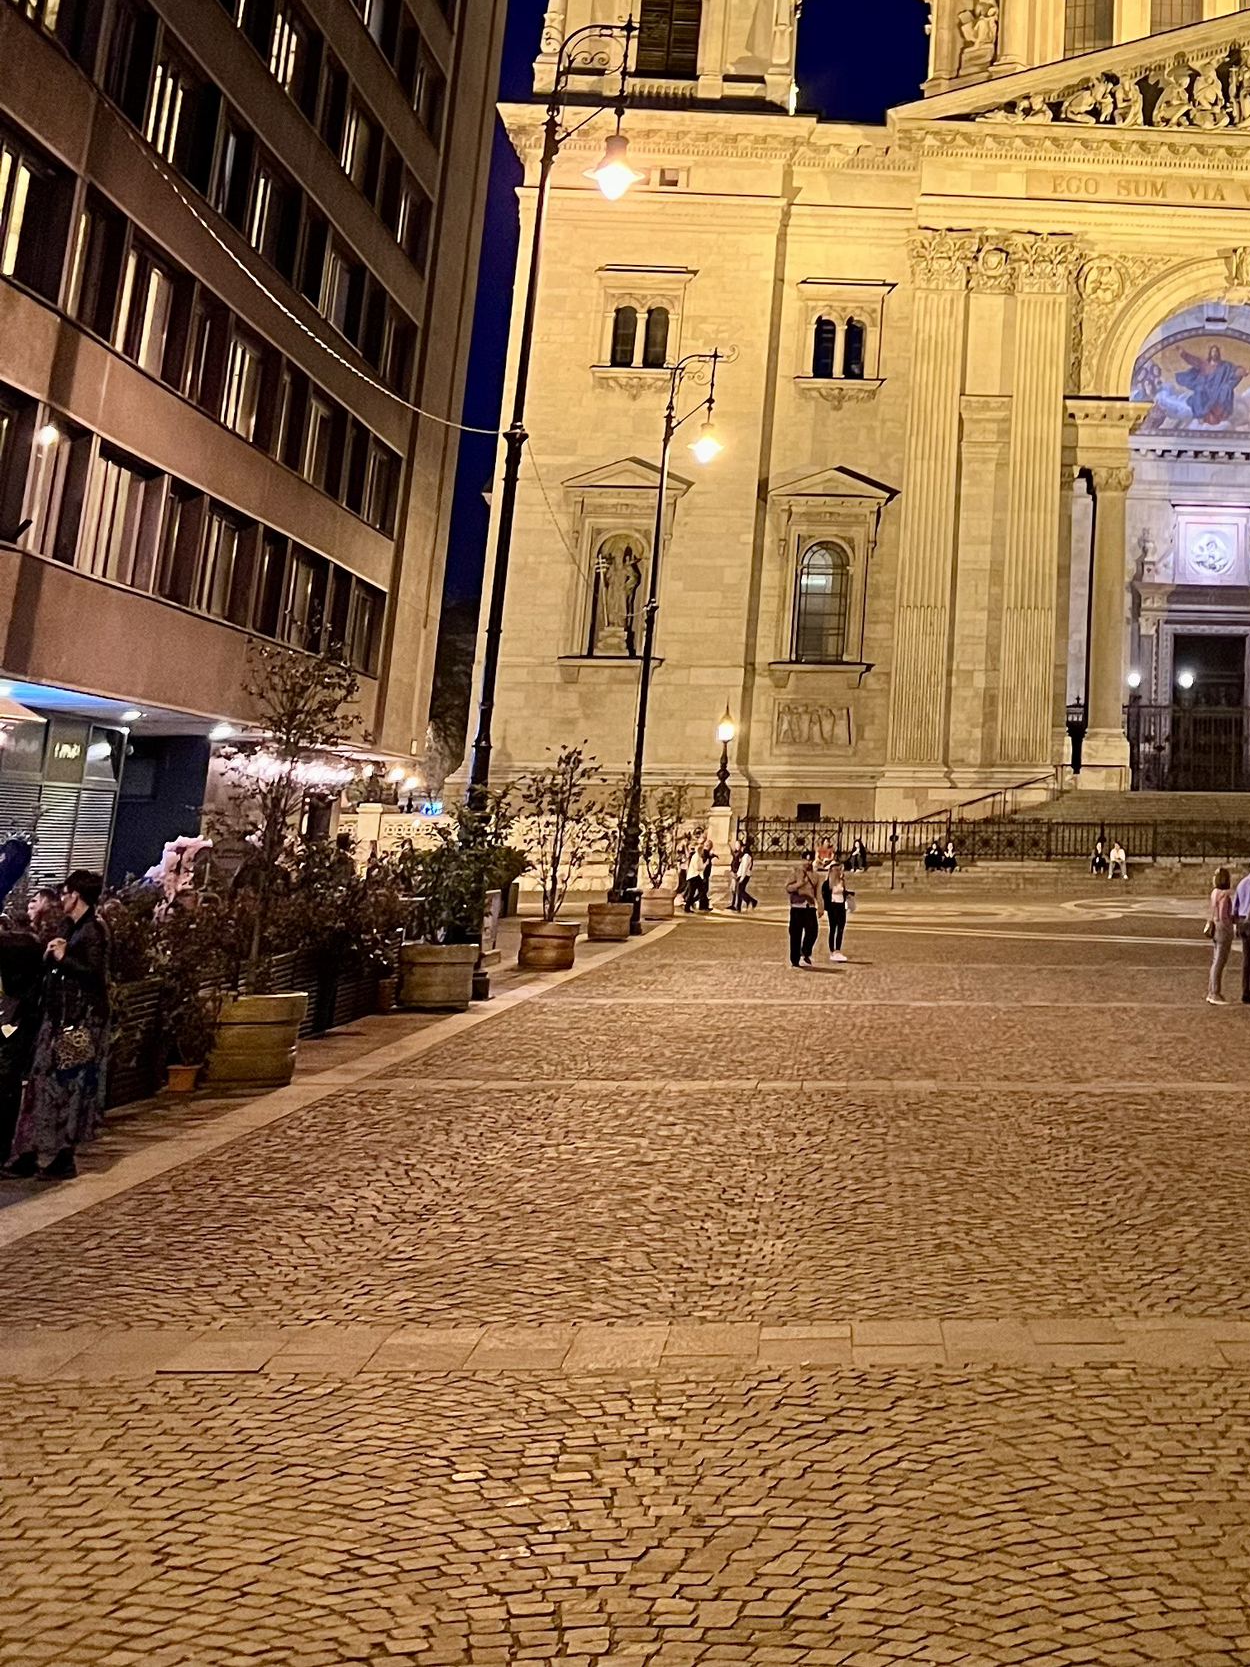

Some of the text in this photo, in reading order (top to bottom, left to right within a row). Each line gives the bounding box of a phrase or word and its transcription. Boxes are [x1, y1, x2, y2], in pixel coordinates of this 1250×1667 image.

[1050, 174, 1100, 196] EGO
[1116, 178, 1168, 199] SUM
[1187, 183, 1227, 202] VIA
